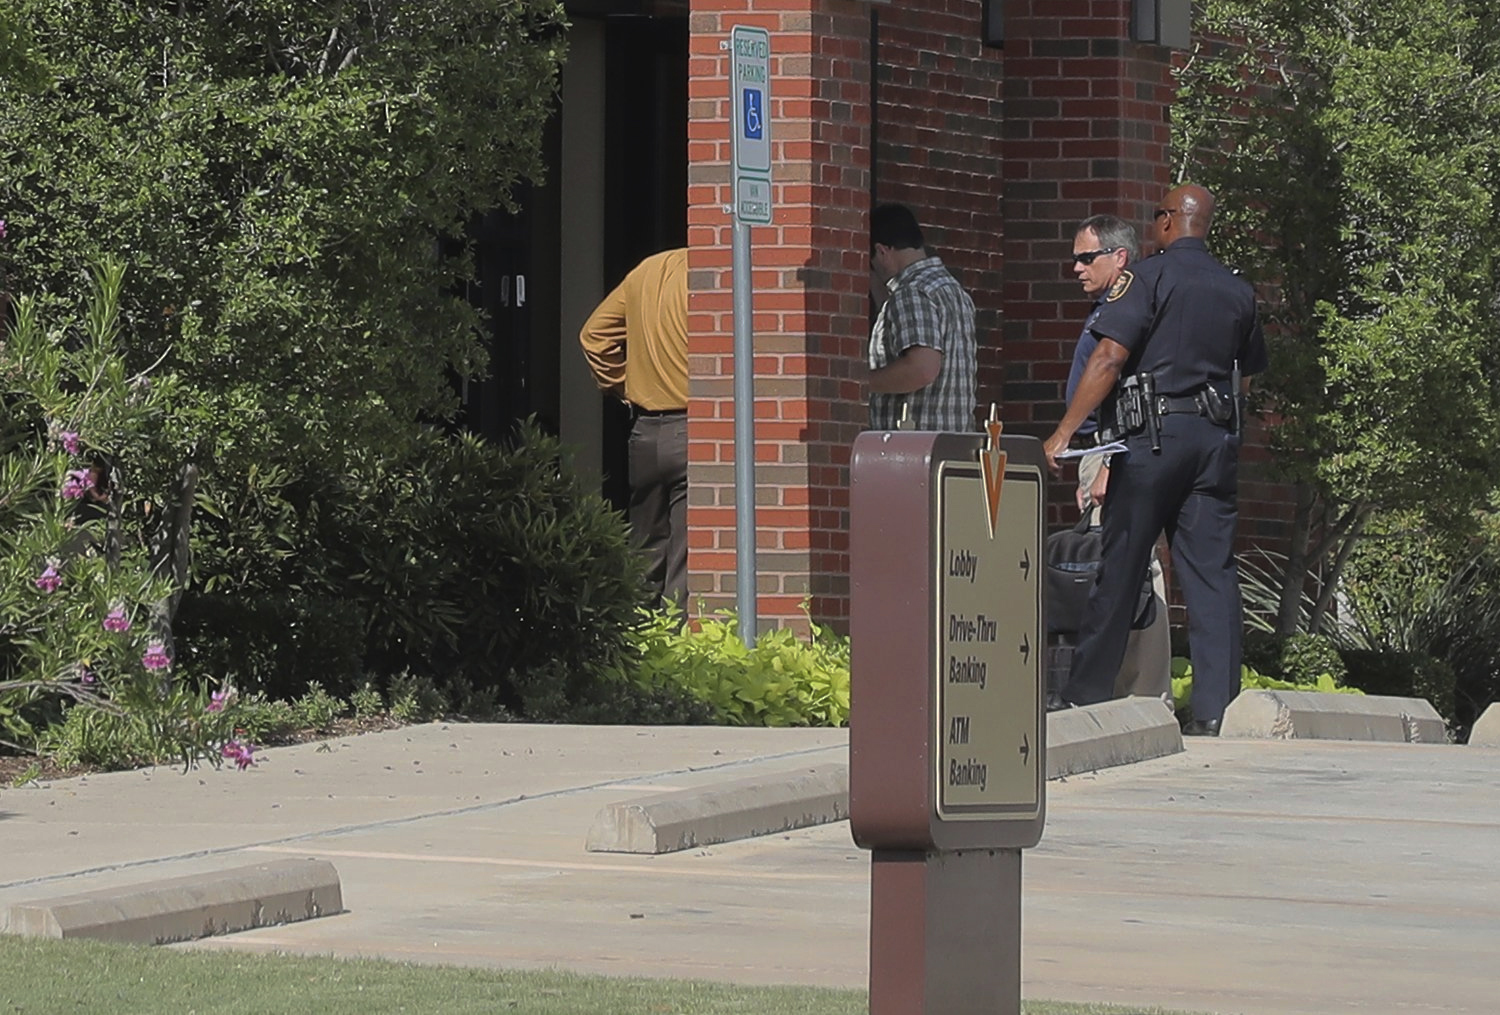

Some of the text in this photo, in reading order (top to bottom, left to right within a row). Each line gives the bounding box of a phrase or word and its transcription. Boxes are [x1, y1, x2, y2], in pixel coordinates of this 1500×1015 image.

[738, 62, 766, 83] PARKING
[949, 549, 977, 584] Lobby
[949, 614, 997, 643] Drive-Thru
[949, 655, 987, 690] Banking
[949, 716, 970, 744] ATM
[949, 758, 987, 792] Banking
